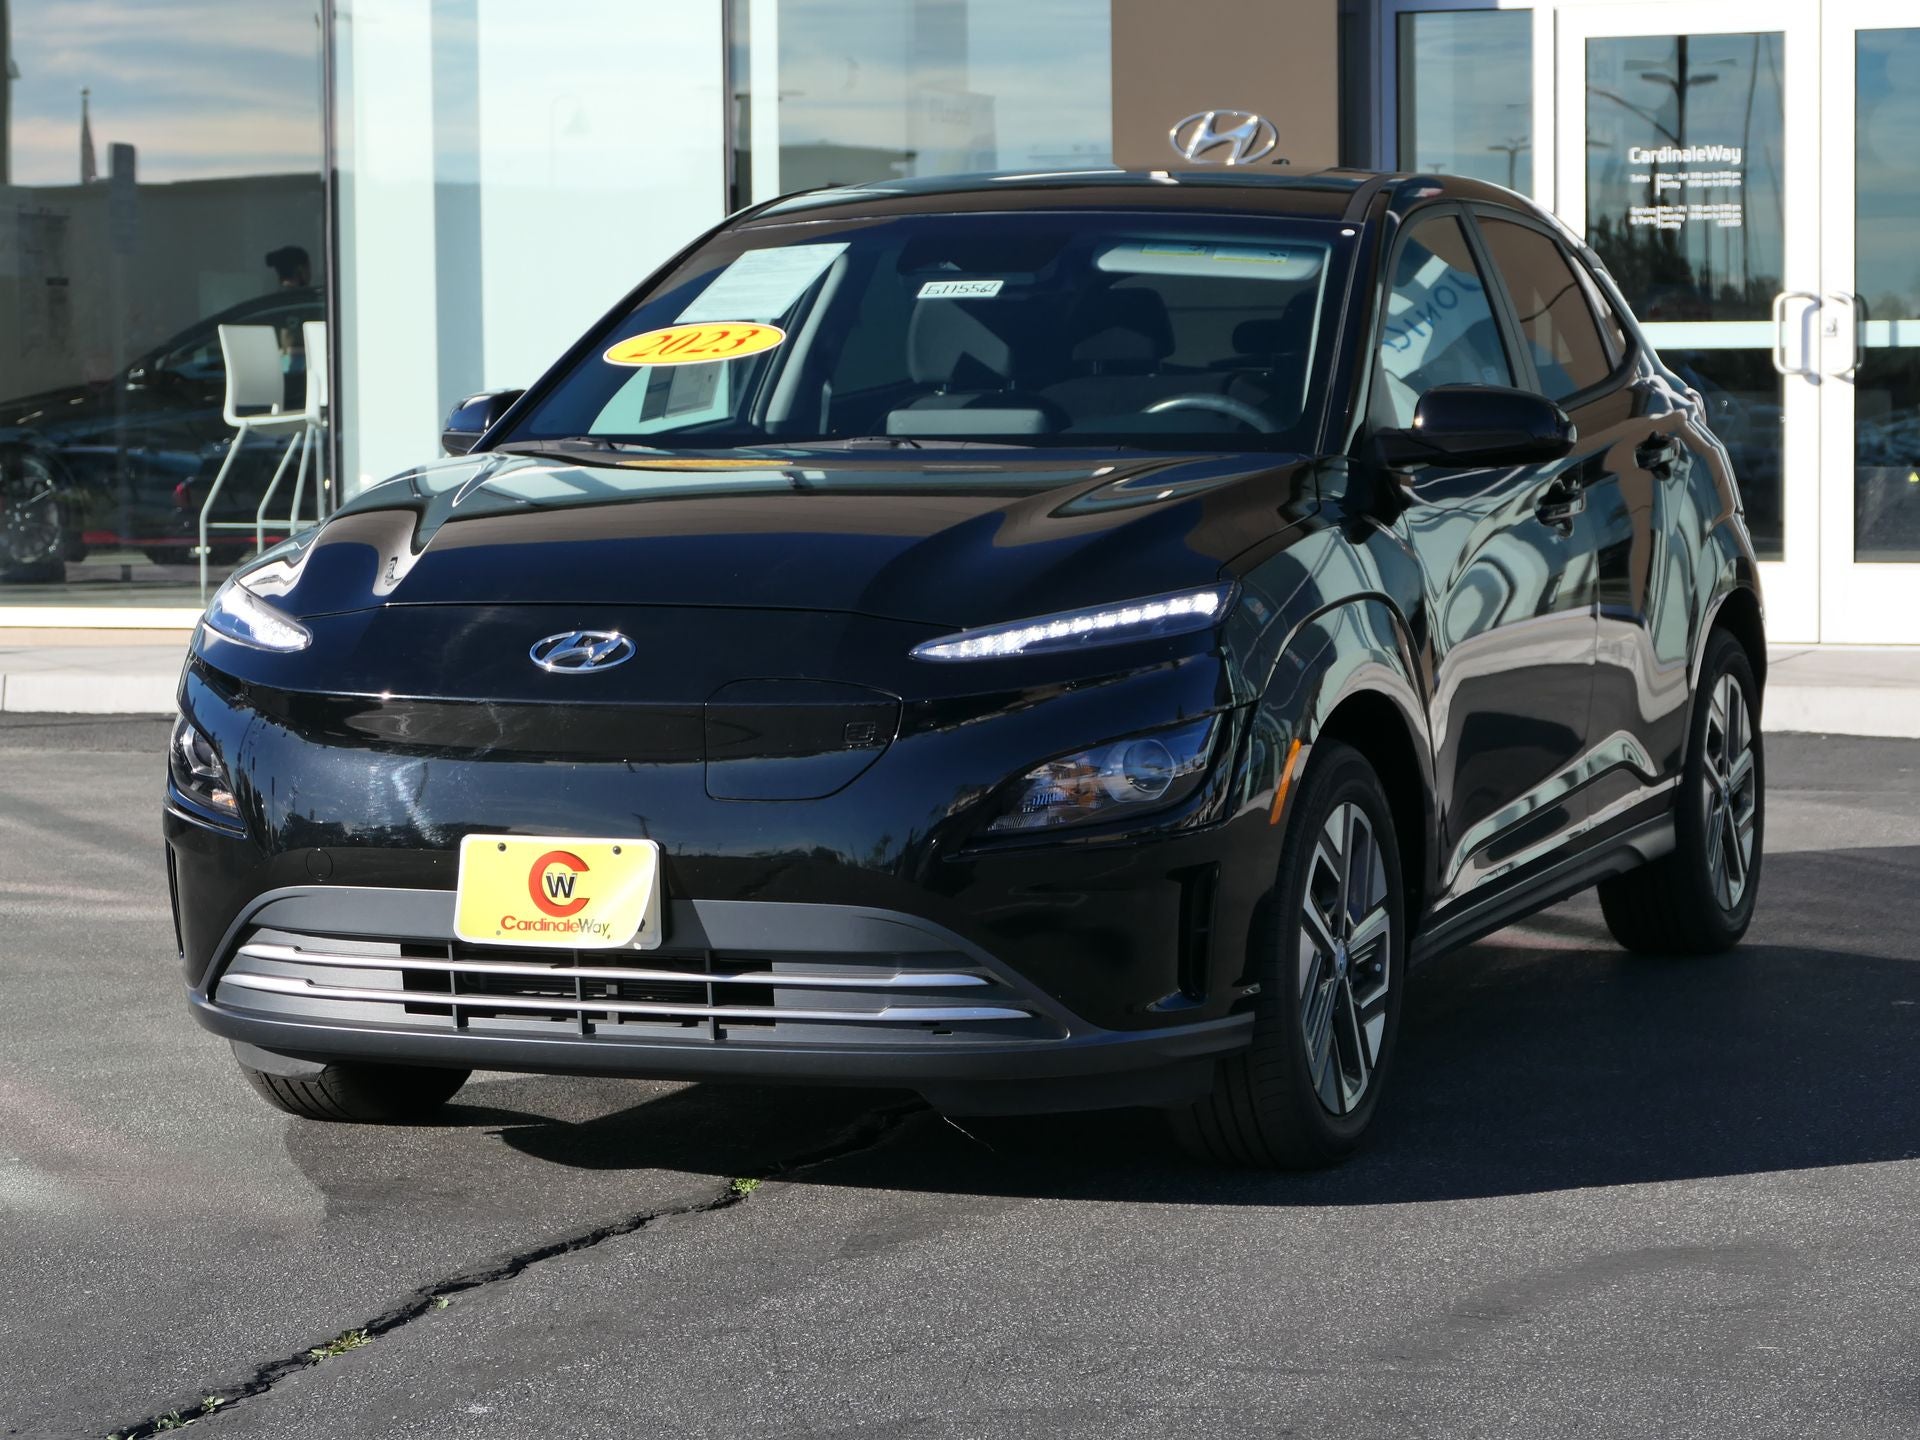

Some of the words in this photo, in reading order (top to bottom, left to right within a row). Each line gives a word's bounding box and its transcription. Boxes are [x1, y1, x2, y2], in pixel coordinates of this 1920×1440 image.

[1628, 145, 1742, 165] CardinaleWay
[626, 329, 760, 358] 2023
[500, 915, 610, 937] CardinaleWay
